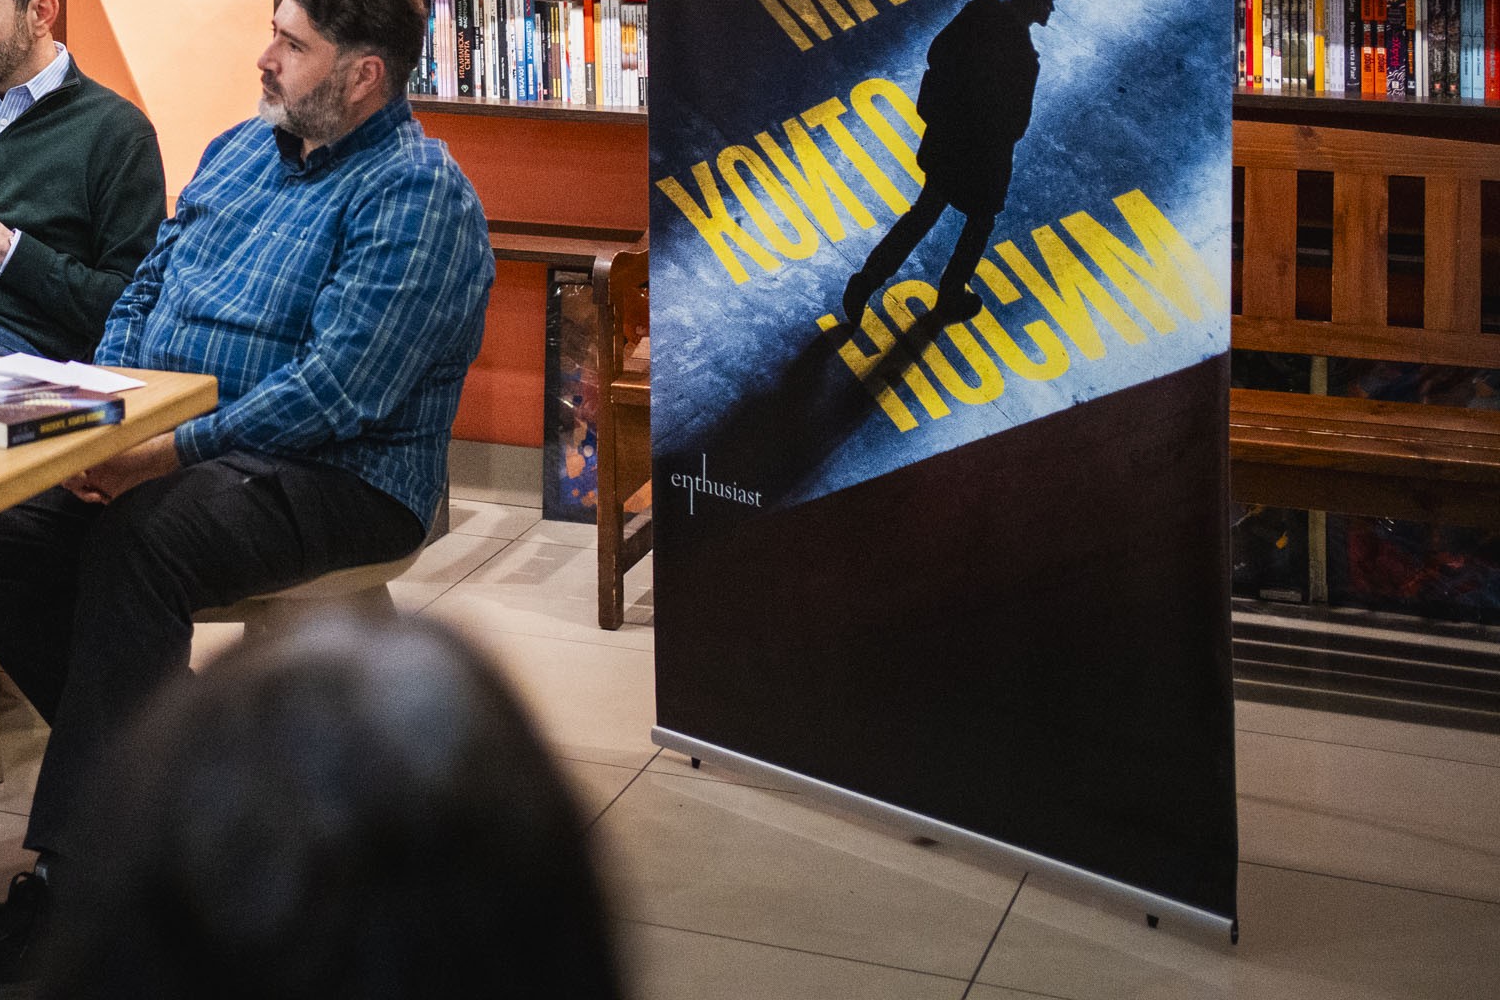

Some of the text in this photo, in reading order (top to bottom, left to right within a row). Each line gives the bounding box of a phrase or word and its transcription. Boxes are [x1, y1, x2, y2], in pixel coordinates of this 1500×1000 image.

[458, 31, 466, 79] ИТАЛИАНСКА
[655, 77, 928, 286] КОИТО
[816, 188, 1227, 433] НОСИМ
[670, 453, 763, 516] enthusiast
